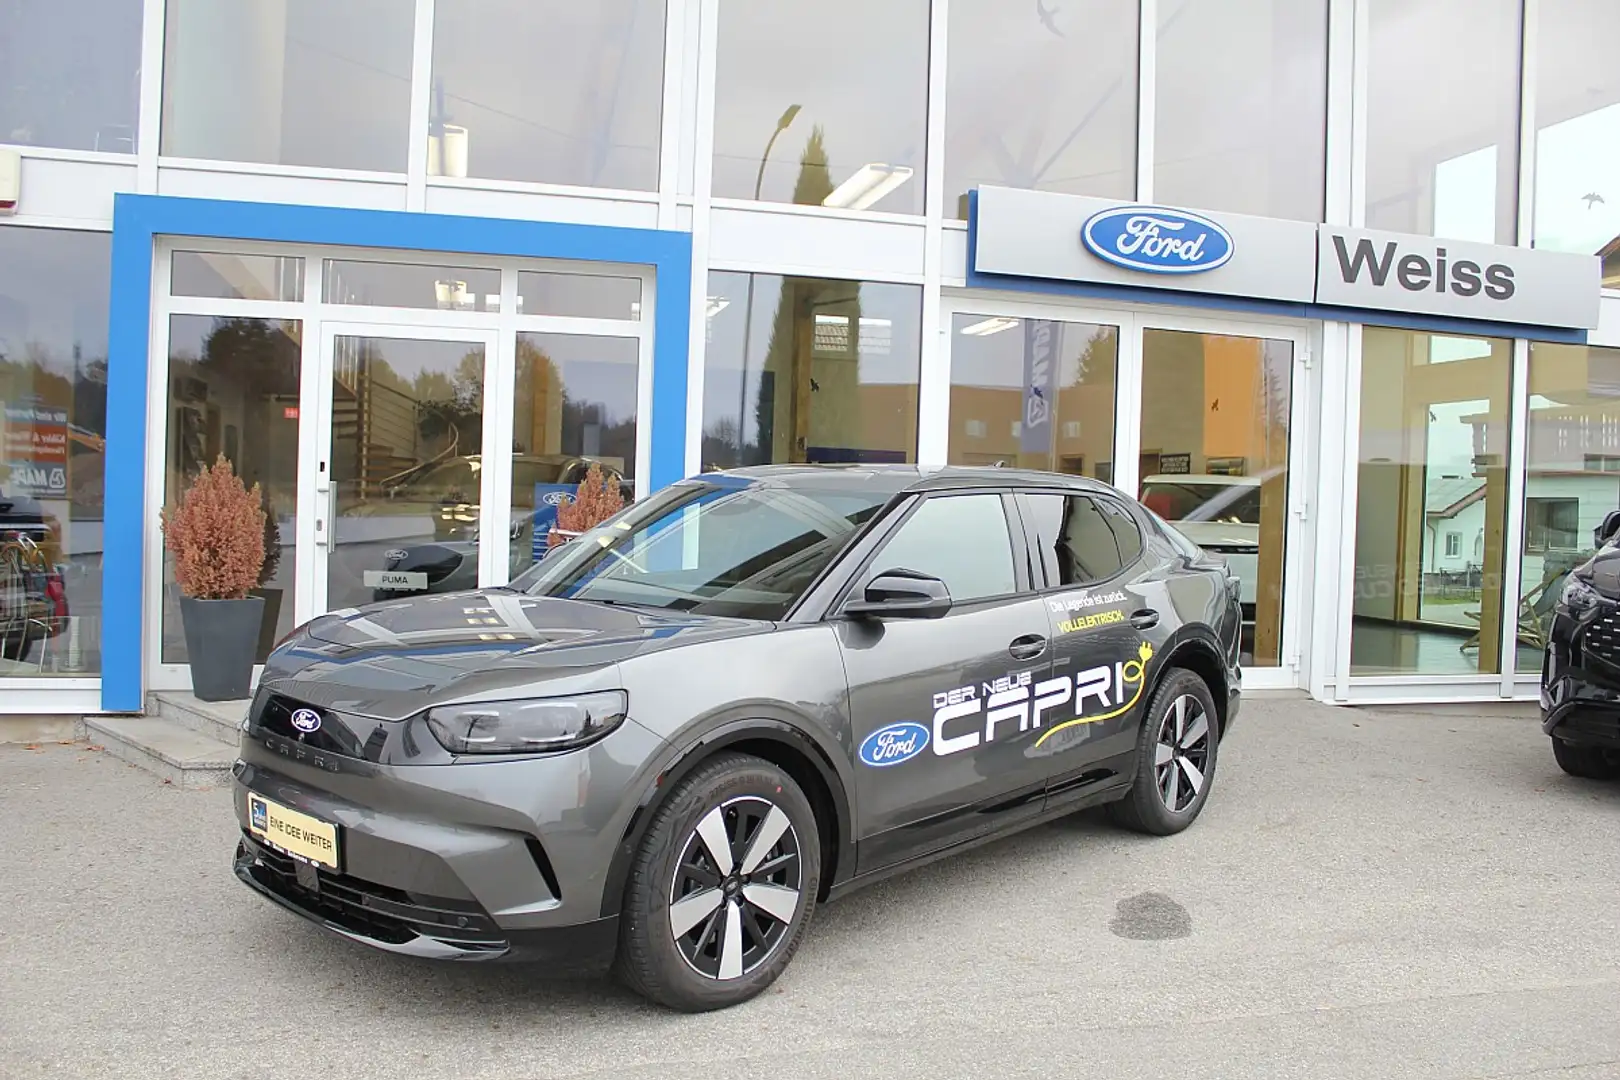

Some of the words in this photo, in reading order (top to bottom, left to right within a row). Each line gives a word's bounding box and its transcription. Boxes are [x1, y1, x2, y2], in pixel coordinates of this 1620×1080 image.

[1115, 214, 1206, 265] Ford
[1332, 233, 1517, 301] Weiss
[381, 575, 409, 584] PUMA
[932, 685, 976, 709] DER
[982, 671, 1032, 695] NEUE
[932, 662, 1124, 757] CAPRI
[872, 729, 917, 762] Ford
[269, 815, 284, 832] EINE
[285, 822, 301, 840] IDEE
[302, 829, 333, 852] WEITER
